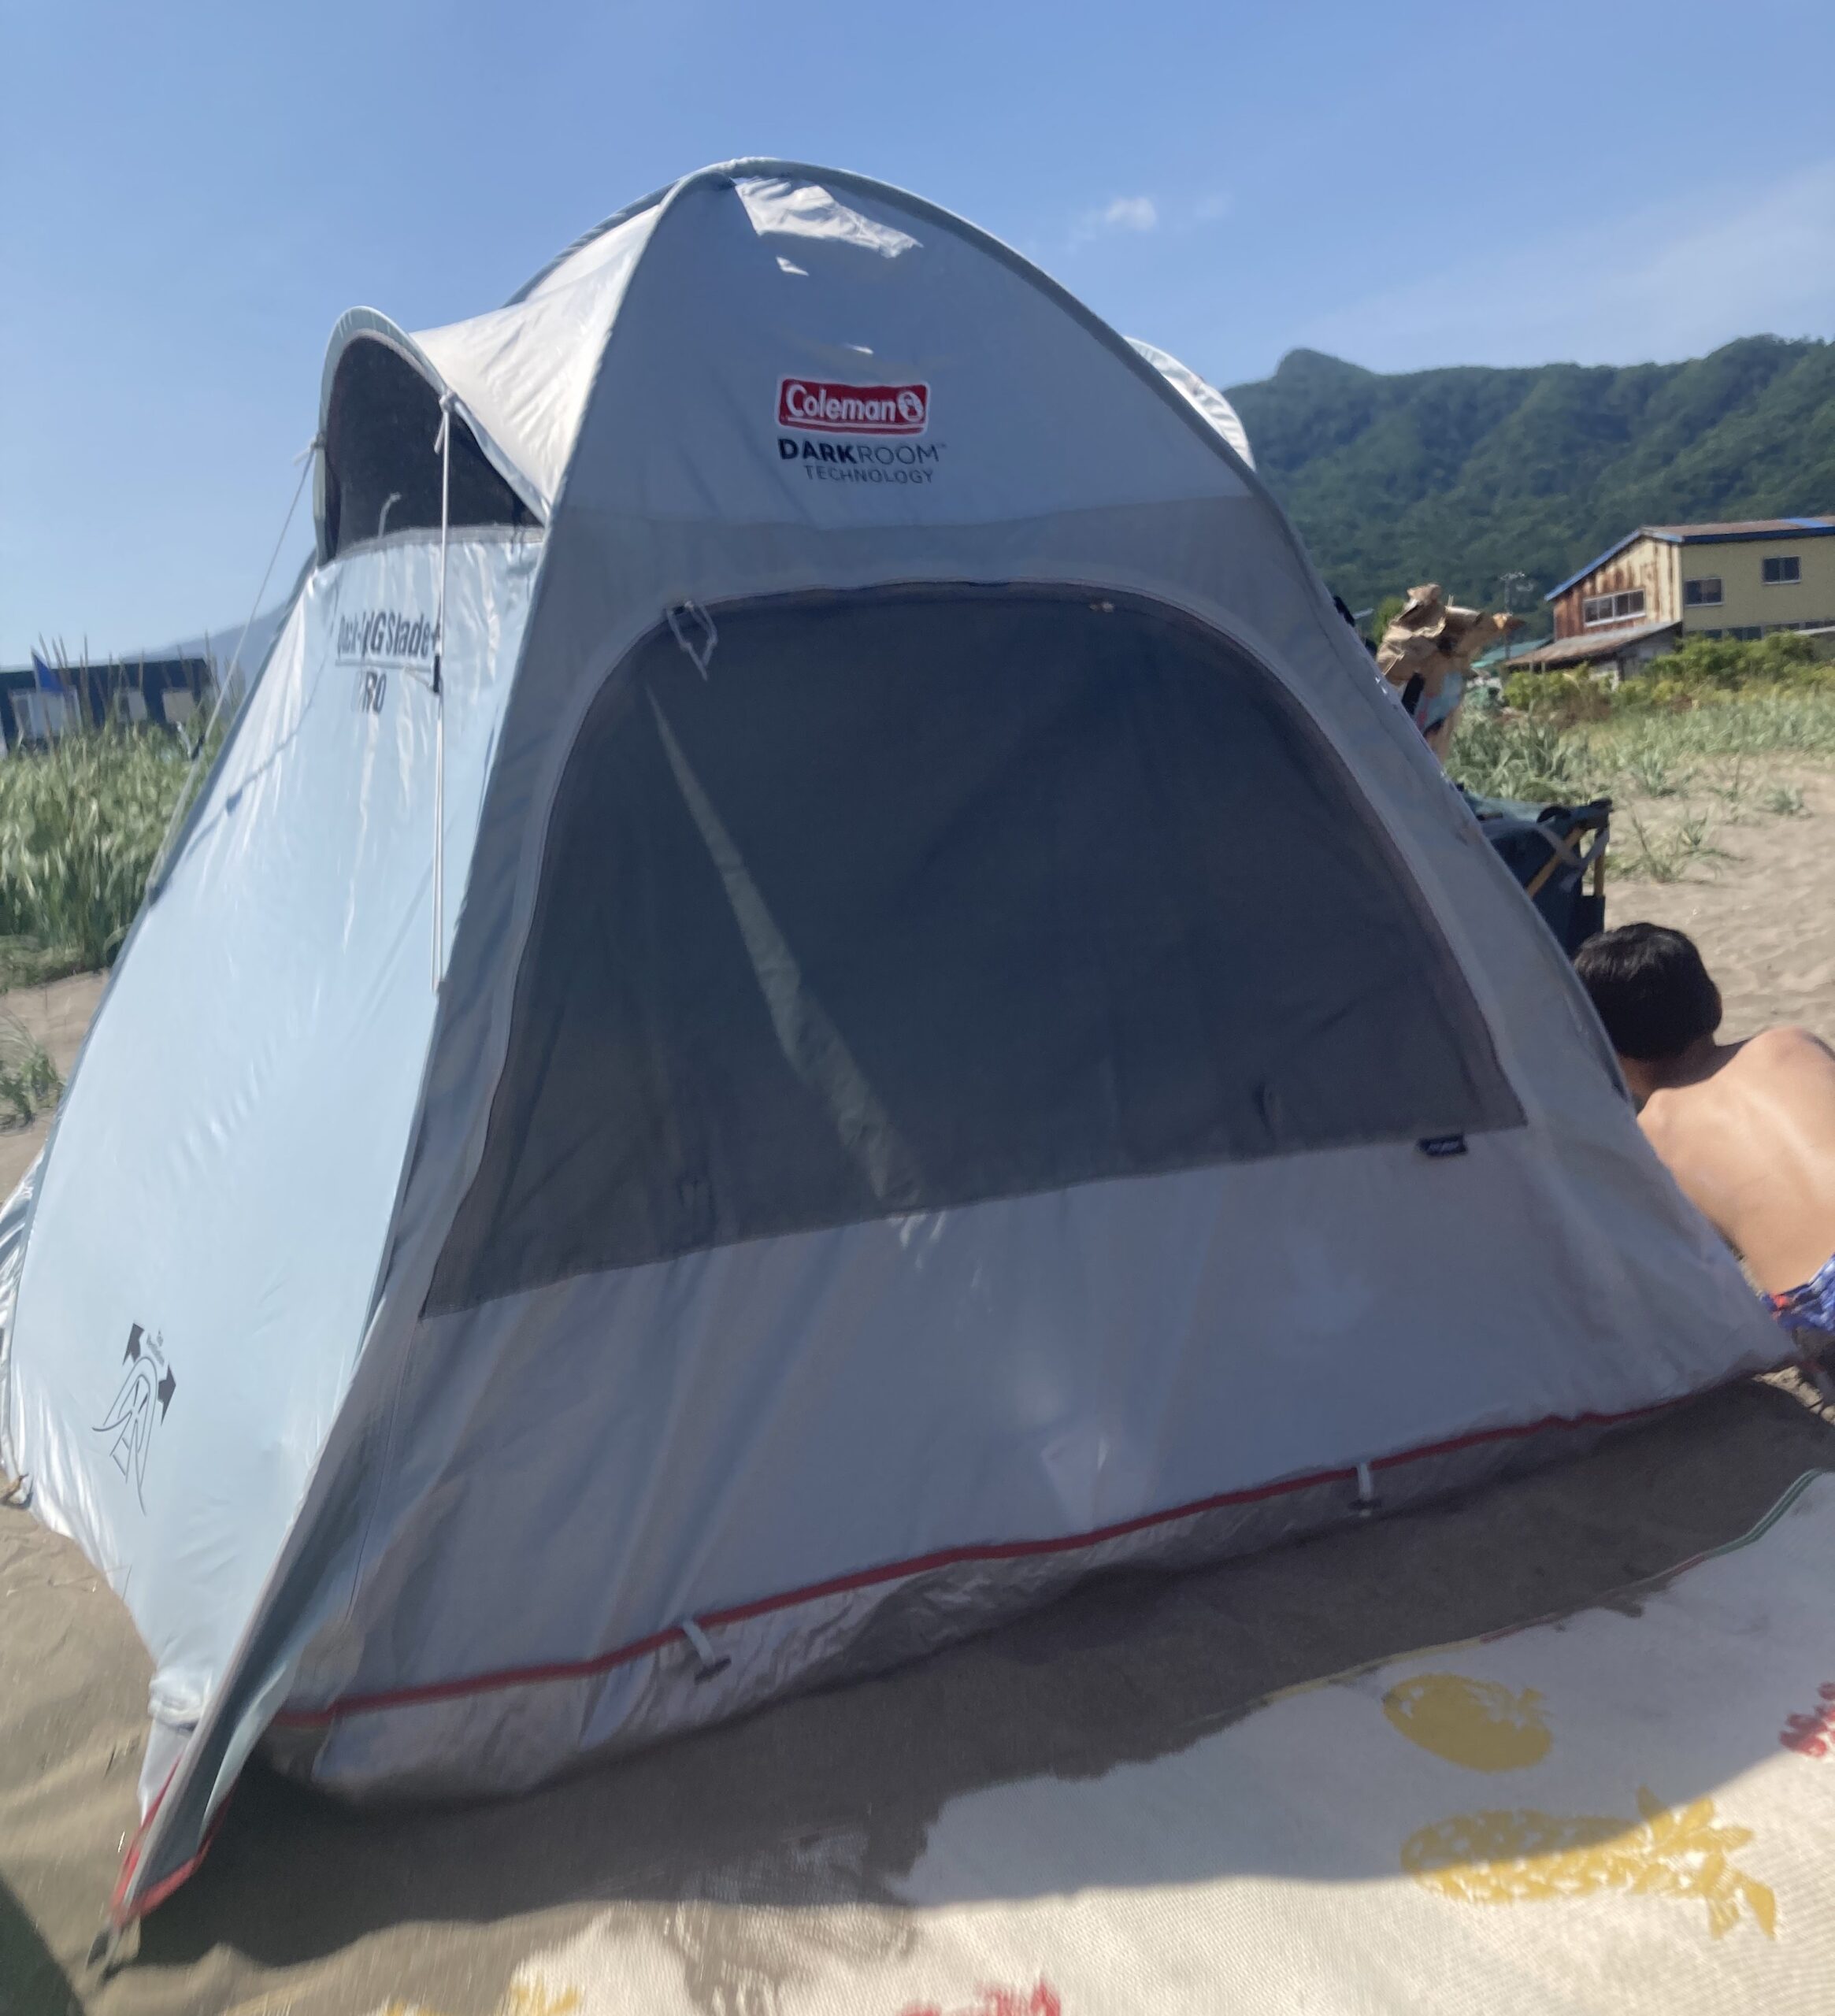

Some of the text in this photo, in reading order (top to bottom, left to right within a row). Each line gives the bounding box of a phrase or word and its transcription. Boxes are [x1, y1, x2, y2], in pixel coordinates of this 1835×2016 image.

[785, 384, 897, 422] Coleman
[777, 438, 940, 465] DARKROOM
[804, 465, 934, 484] TECHNOLOGY
